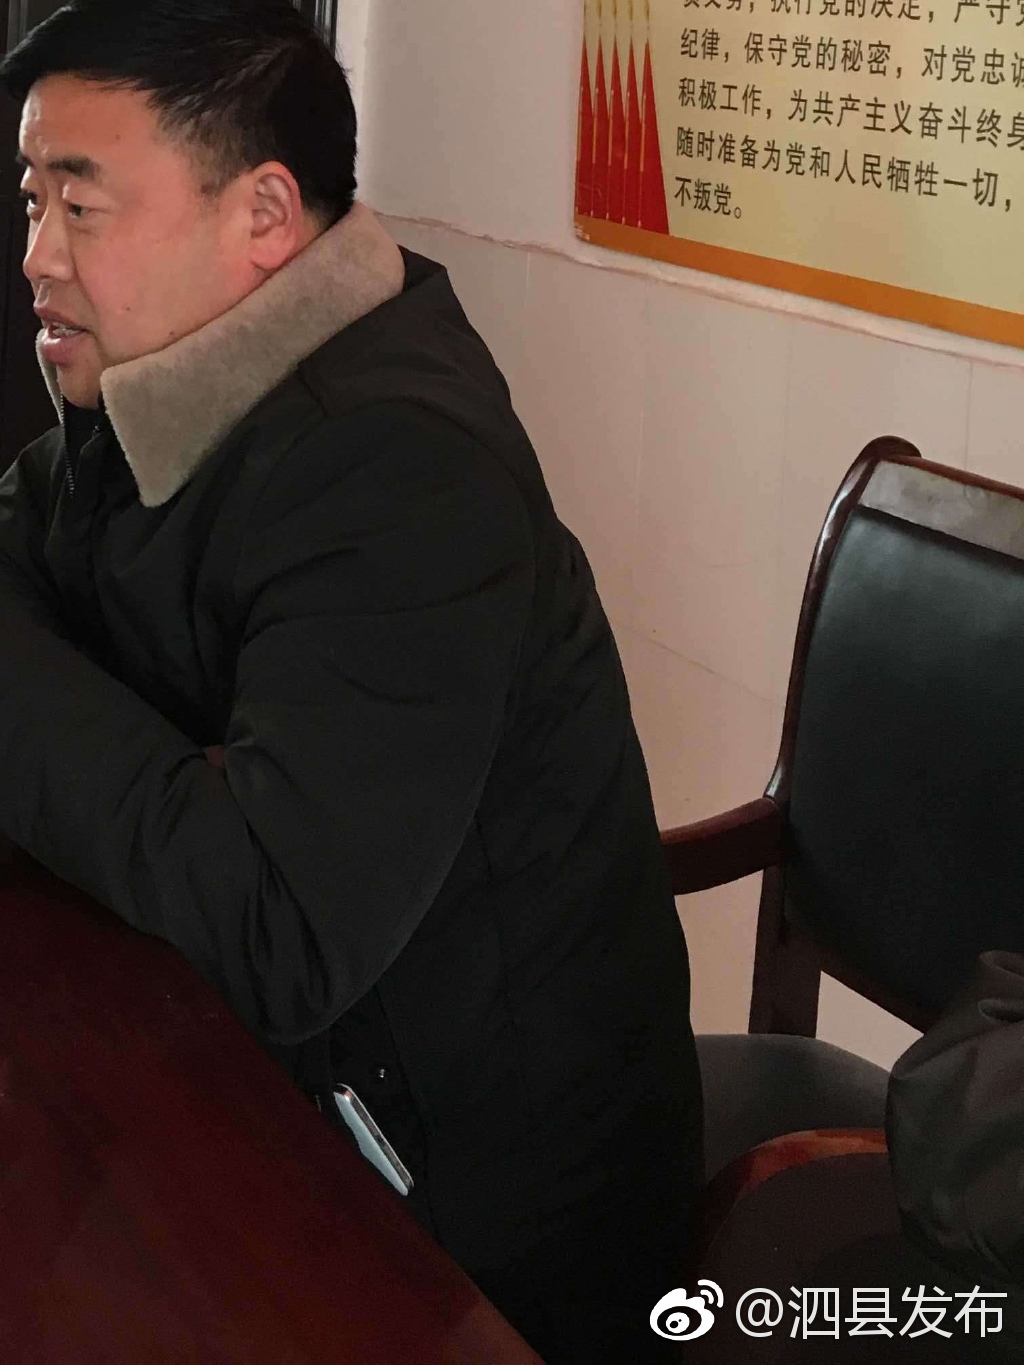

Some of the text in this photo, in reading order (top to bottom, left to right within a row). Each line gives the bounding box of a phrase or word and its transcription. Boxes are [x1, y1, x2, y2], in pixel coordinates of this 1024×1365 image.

[674, 176, 742, 219] 不叛党。
[676, 126, 1011, 212] 随时准备为党和人民牺牲一切，
